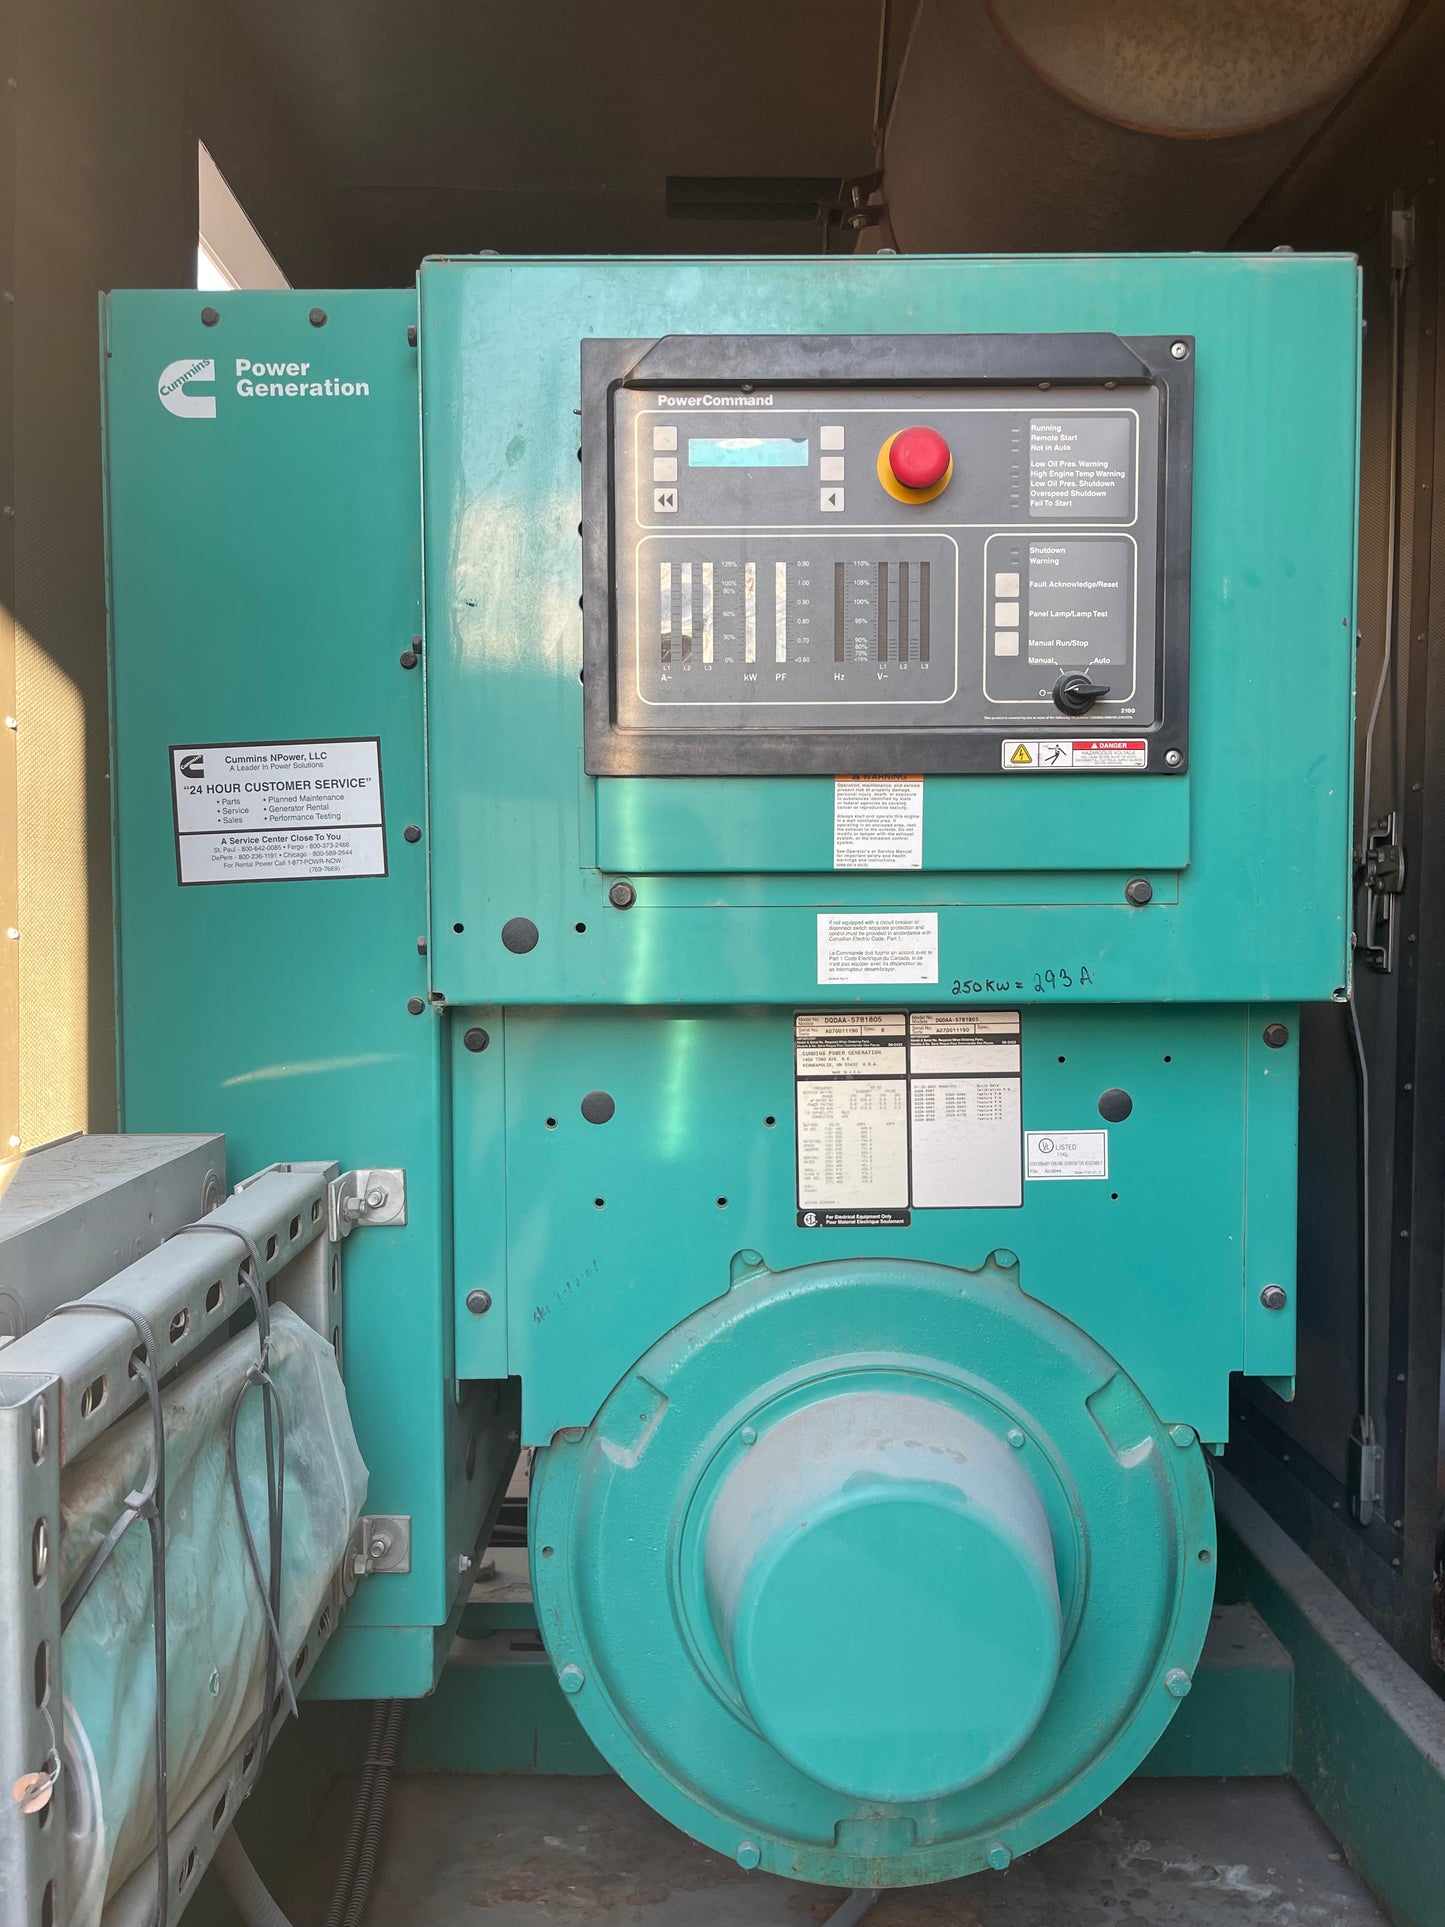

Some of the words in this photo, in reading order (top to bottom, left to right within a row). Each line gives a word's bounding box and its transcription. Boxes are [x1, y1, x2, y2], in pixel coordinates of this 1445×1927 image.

[236, 358, 310, 376] Power
[159, 358, 211, 396] Cummins
[236, 378, 370, 396] Generation
[658, 395, 774, 406] PowerCommand
[1031, 425, 1062, 433] Running
[744, 673, 757, 681] kW
[834, 673, 845, 681] Hz
[225, 755, 267, 764] Cummins
[270, 754, 306, 762] NPower,
[309, 752, 327, 760] LLC
[207, 783, 241, 794] HOUR
[245, 780, 311, 792] CUSTOMER
[300, 794, 344, 802] Maintenance
[270, 814, 314, 822] Performance
[1033, 968, 1073, 993] 293
